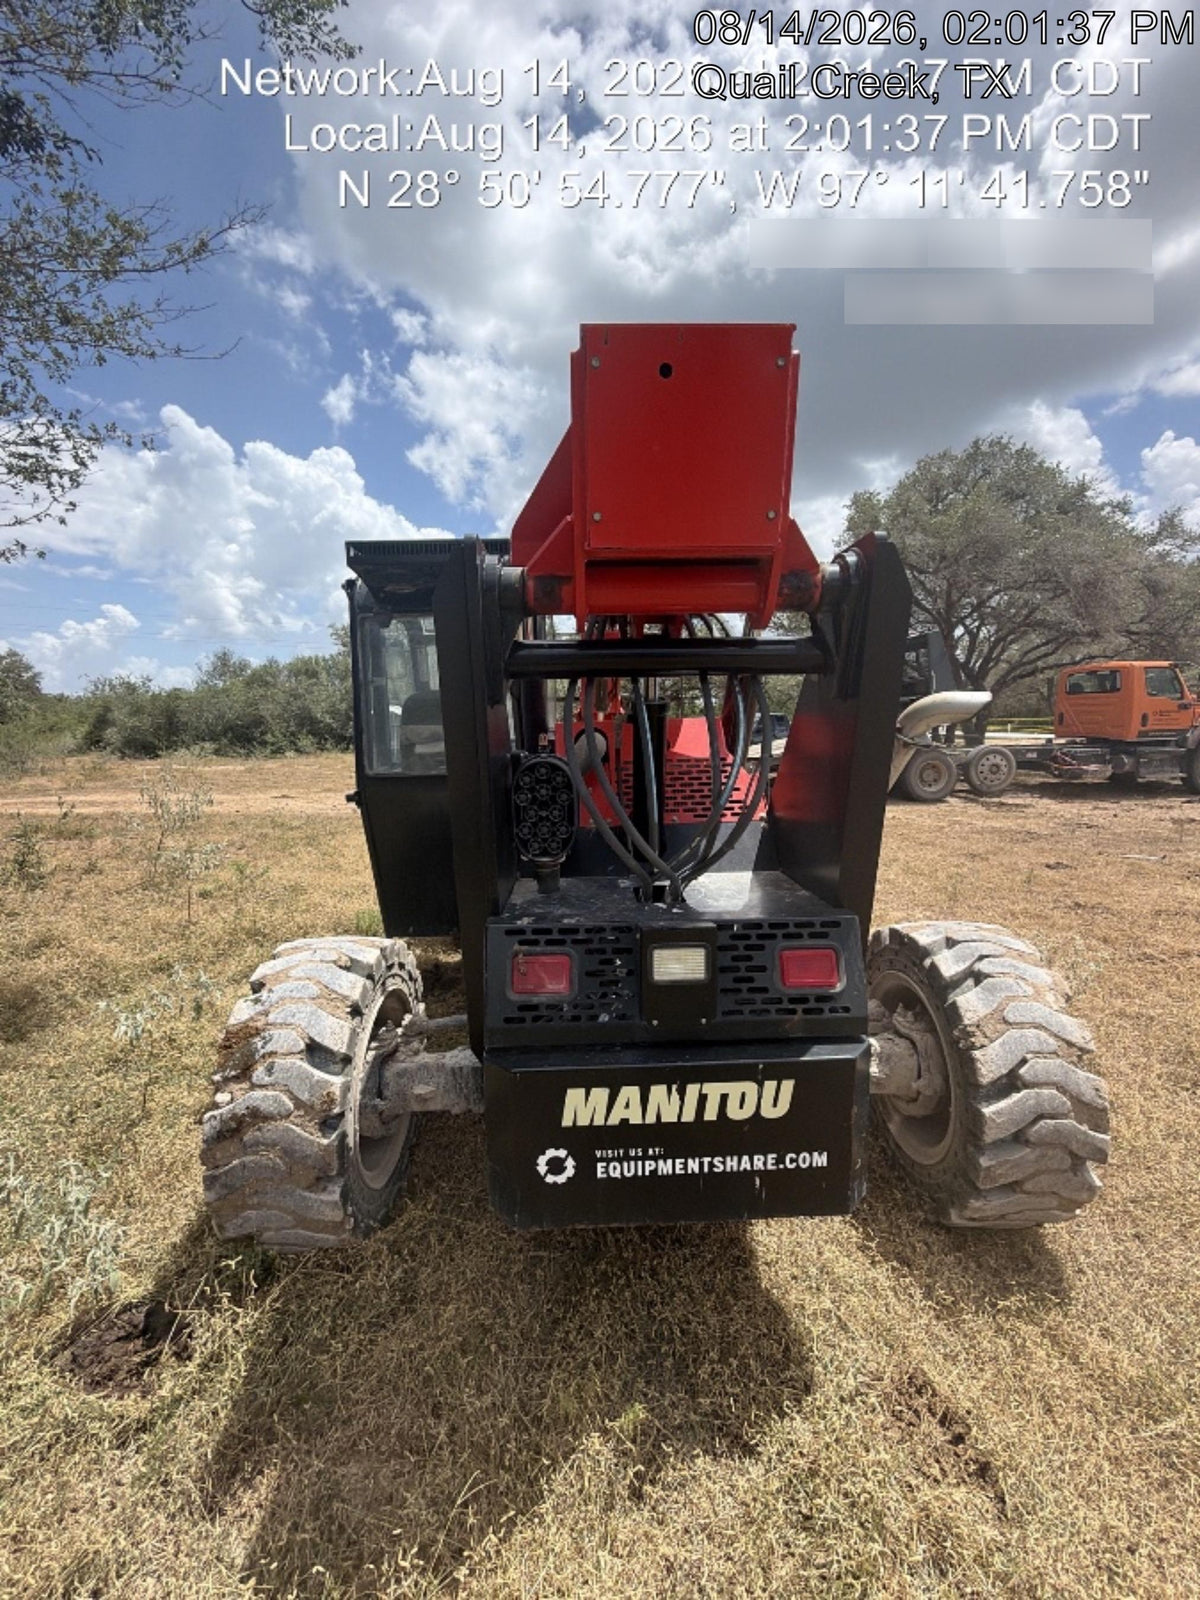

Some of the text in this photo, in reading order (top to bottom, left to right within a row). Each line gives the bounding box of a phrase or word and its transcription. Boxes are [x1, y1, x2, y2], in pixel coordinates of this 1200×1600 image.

[561, 1079, 796, 1127] MANITOU
[594, 1146, 664, 1158] VISIT US AT:
[596, 1151, 829, 1179] EQUIPMENTSHARE.COM
